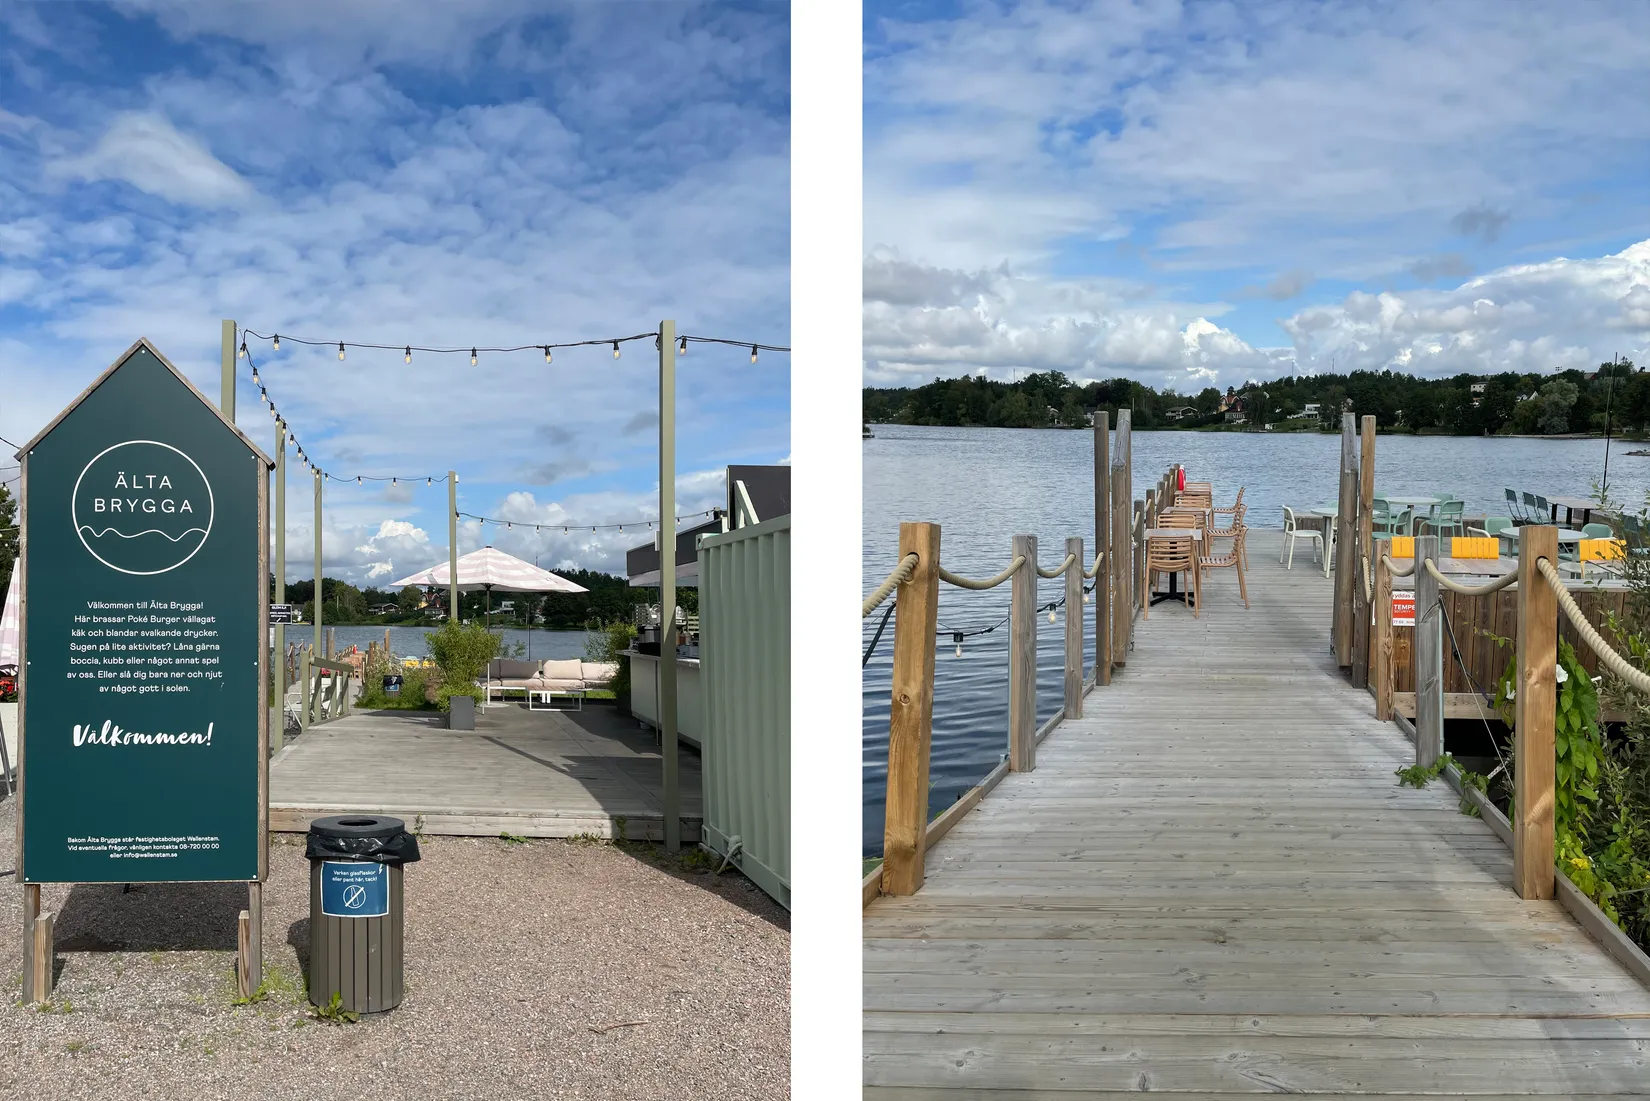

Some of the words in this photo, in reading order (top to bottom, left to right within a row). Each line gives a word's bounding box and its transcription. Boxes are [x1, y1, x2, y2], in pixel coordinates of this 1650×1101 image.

[115, 472, 172, 489] ÄLTA
[95, 499, 192, 513] BRYGGA
[86, 601, 134, 610] Välkommen
[135, 601, 148, 610] till
[149, 599, 168, 610] Älta
[170, 601, 204, 612] Brygga!
[74, 615, 91, 623] Här
[92, 615, 126, 623] brassar
[127, 614, 149, 623] Poké
[150, 614, 181, 625] Burger
[182, 615, 216, 625] vällagat
[71, 628, 86, 637] käk
[87, 628, 104, 637] och
[105, 628, 139, 637] blandar
[140, 628, 182, 637] svalkande
[183, 628, 219, 639] drycker.
[69, 642, 98, 653] Sugen
[99, 642, 110, 653] på
[111, 642, 127, 651] lite
[128, 642, 172, 651] aktivitet?
[173, 642, 194, 651] Låna
[195, 642, 220, 653] gärna
[70, 656, 101, 665] boccia,
[102, 656, 125, 665] kubb
[125, 656, 146, 665] eller
[147, 656, 173, 667] något
[174, 657, 200, 665] annat
[201, 656, 220, 666] spel
[97, 670, 118, 679] Eller
[119, 670, 132, 679] slå
[133, 670, 147, 681] dig
[148, 670, 169, 679] bara
[170, 671, 186, 679] ner
[186, 670, 203, 679] och
[205, 670, 223, 680] njut
[111, 684, 137, 695] något
[138, 684, 160, 695] gott
[165, 684, 191, 693] solen.
[73, 720, 213, 746] Välkommen!
